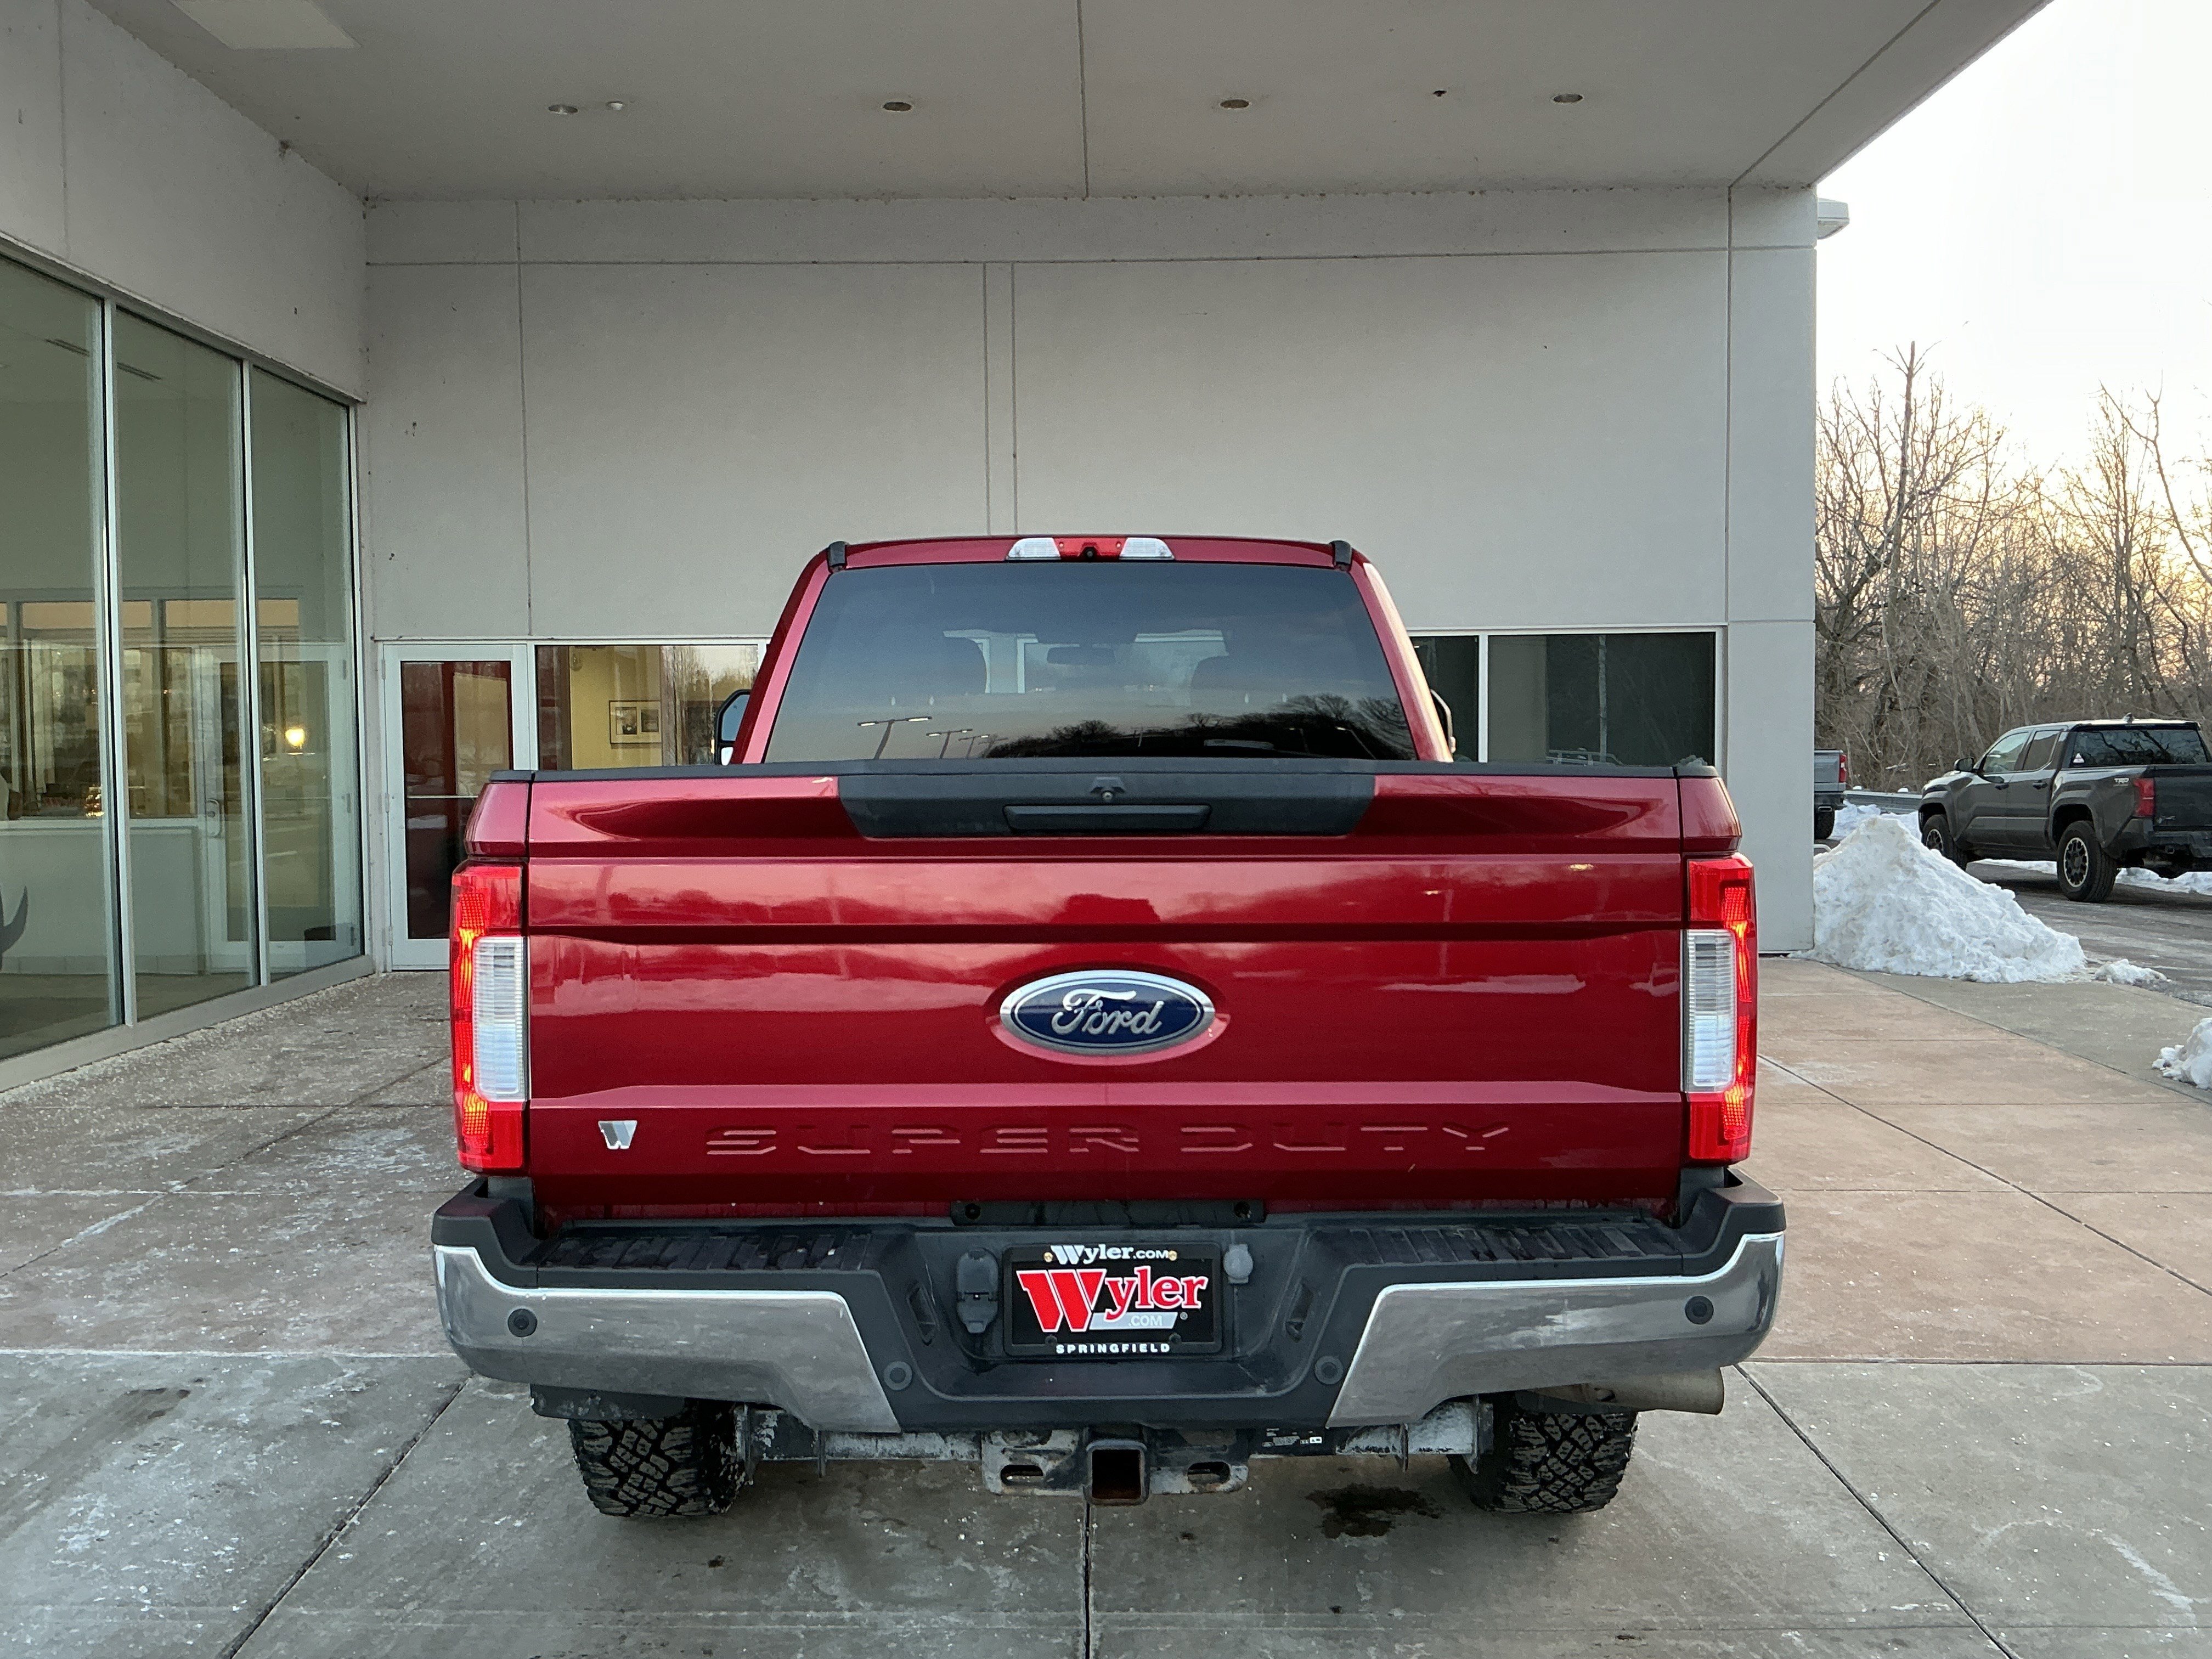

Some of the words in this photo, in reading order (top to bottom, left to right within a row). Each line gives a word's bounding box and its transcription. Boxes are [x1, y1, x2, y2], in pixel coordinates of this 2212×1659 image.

[1051, 988, 1165, 1035] Ford
[706, 1124, 1139, 1155] SUPER
[1180, 1121, 1510, 1153] DUTY
[1016, 1266, 1208, 1332] Wyler
[1056, 1344, 1170, 1353] SPRINGFIELD
